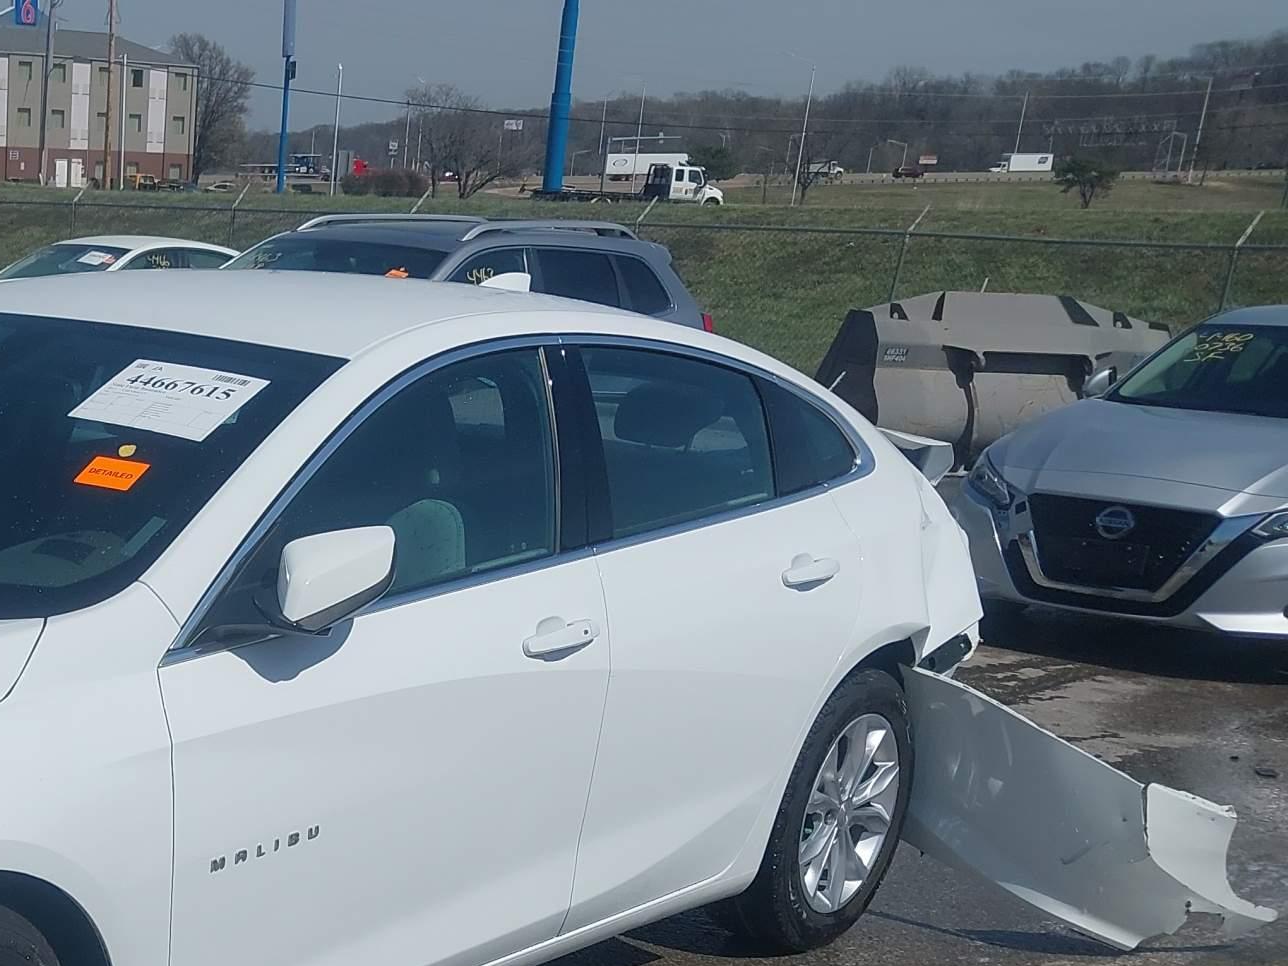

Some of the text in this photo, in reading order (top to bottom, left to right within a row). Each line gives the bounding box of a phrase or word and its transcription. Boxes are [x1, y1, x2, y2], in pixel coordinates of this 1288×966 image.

[21, 0, 36, 24] 6
[126, 374, 238, 401] 44667615
[88, 467, 134, 480] DETAILED
[210, 825, 320, 873] MALIBU
